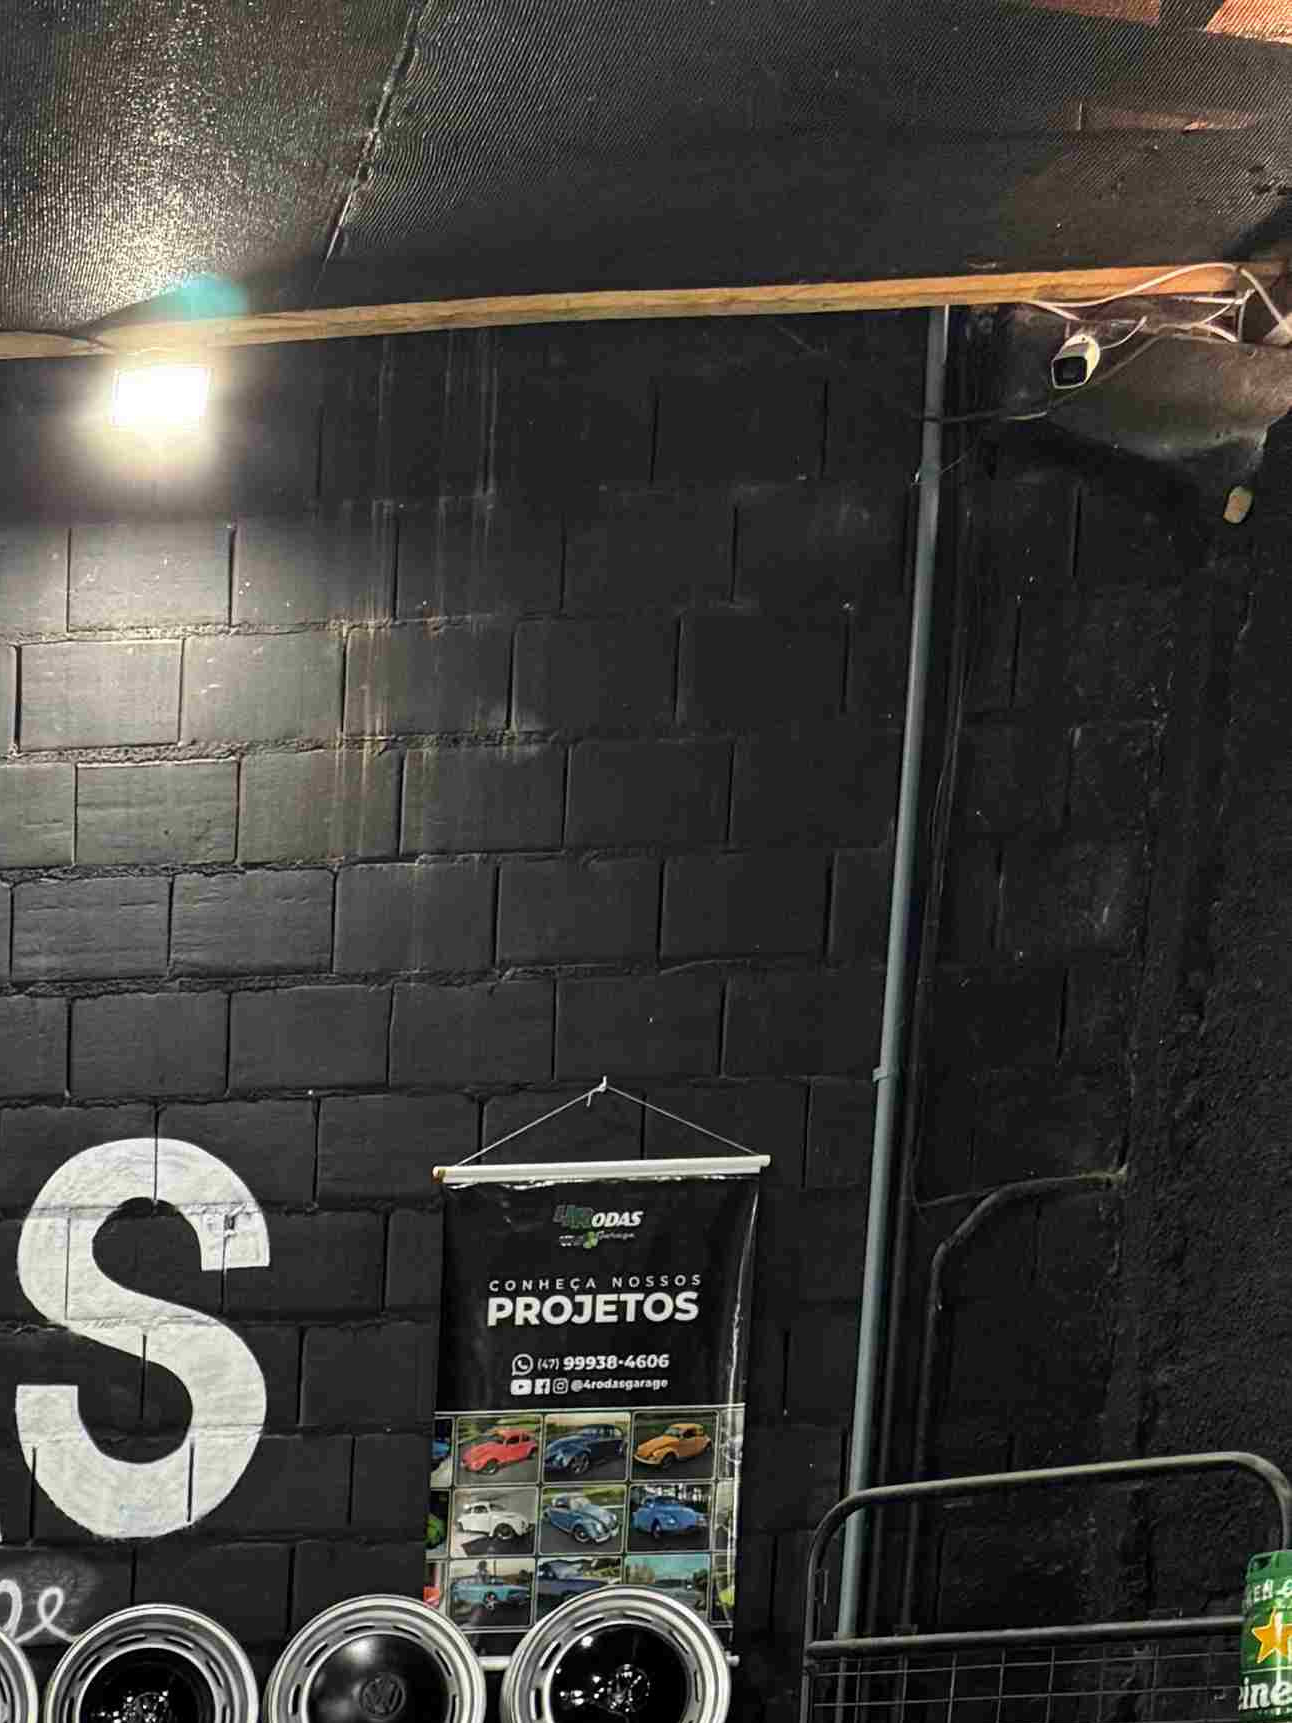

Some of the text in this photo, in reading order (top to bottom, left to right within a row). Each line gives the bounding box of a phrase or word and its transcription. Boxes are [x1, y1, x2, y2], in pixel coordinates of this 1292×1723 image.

[489, 1274, 702, 1291] CONHEÇA NOSSOS
[486, 1291, 700, 1327] PROJETOS
[537, 1353, 670, 1371] (47) 99938-4606
[570, 1378, 669, 1393] @4rodasgarage
